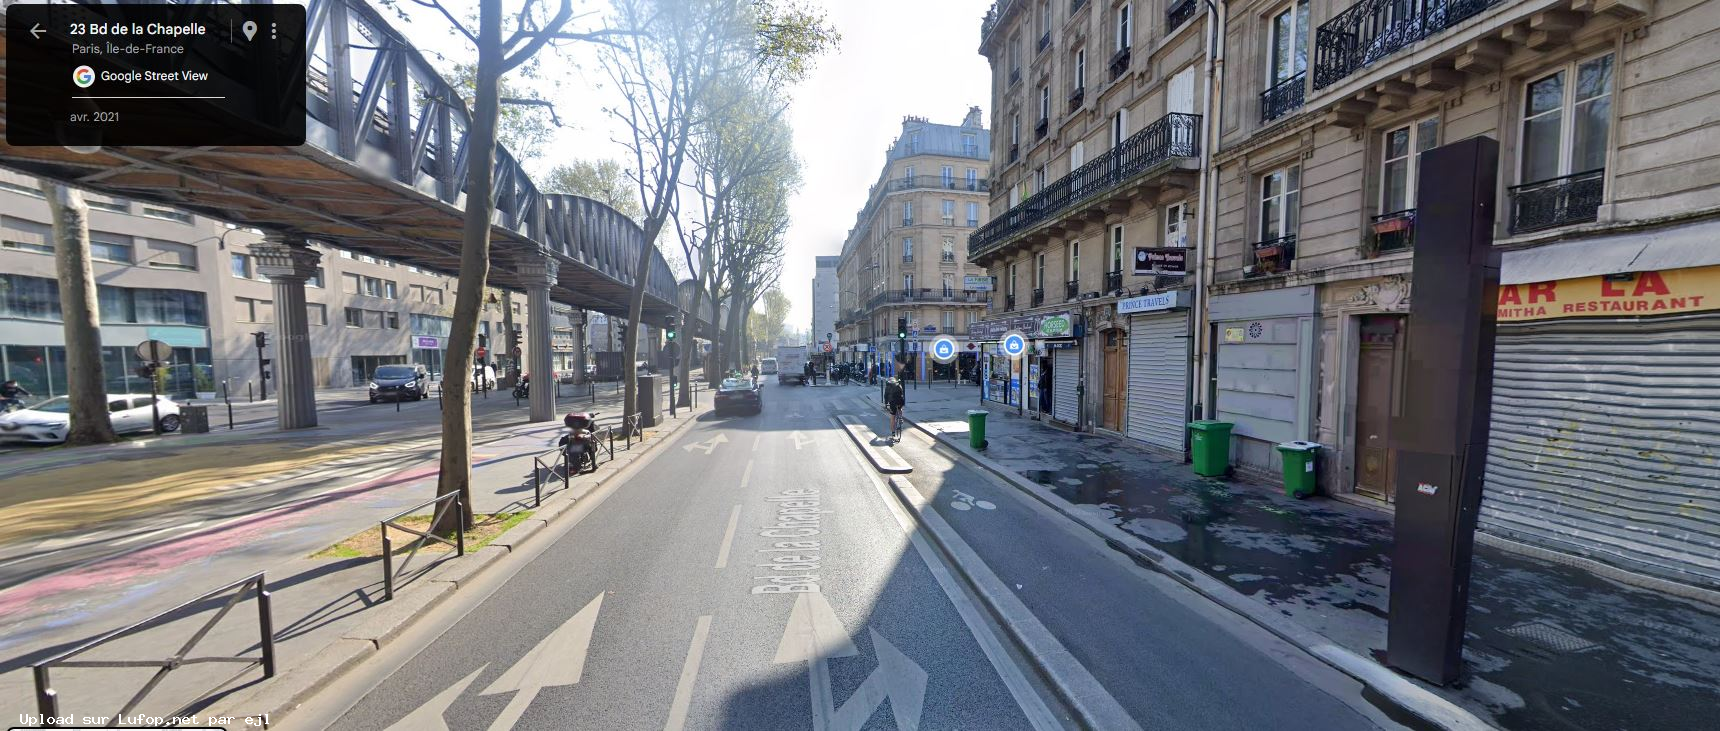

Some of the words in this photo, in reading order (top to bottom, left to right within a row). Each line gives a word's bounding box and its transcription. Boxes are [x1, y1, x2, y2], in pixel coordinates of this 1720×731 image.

[1122, 300, 1142, 310] PRINCE
[1144, 296, 1170, 307] TRAVELS
[1563, 295, 1705, 313] RESTAURANT
